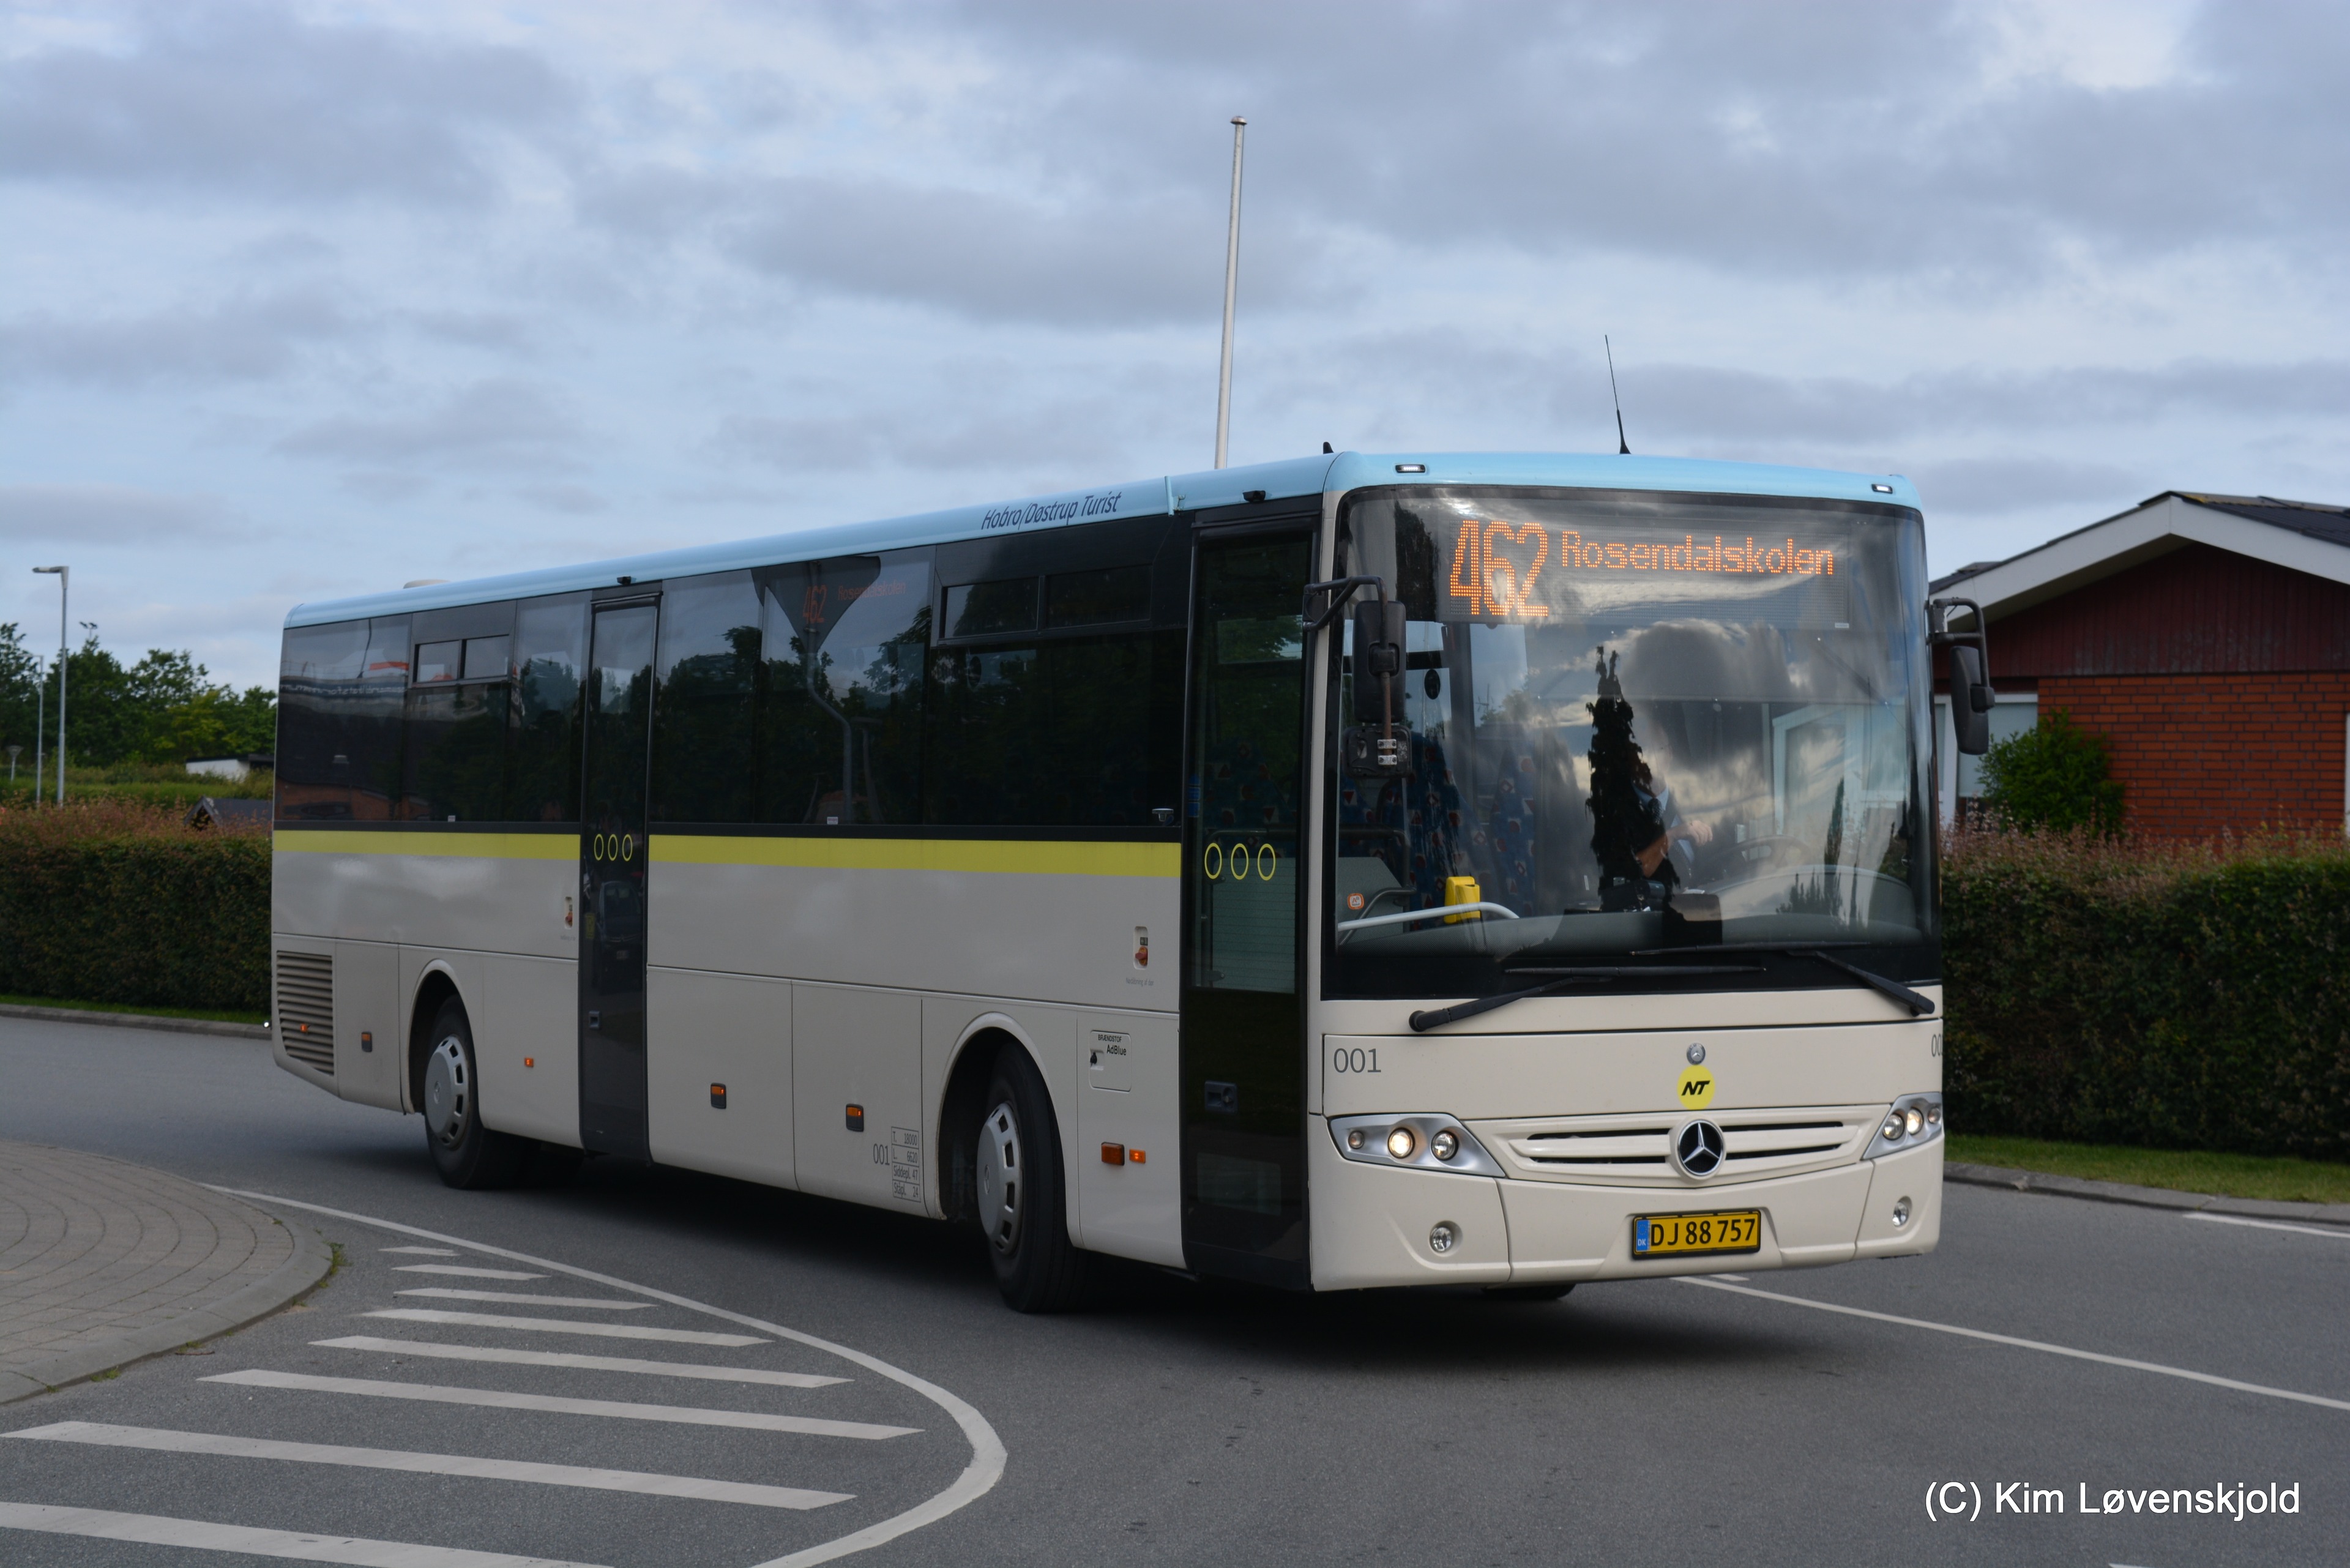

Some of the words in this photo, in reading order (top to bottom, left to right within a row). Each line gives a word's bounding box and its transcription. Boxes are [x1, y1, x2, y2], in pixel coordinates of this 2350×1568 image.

[981, 501, 1079, 531] Hobro/Døstrup
[1081, 491, 1122, 517] Turist
[1450, 520, 1548, 617] 462
[1561, 530, 1833, 575] Rosendalskolen
[802, 584, 828, 624] 462
[1106, 1045, 1127, 1056] AdBlue
[1333, 1048, 1382, 1073] 001
[1680, 1080, 1710, 1096] NT
[873, 1143, 890, 1166] 001
[1651, 1223, 1679, 1247] DJ
